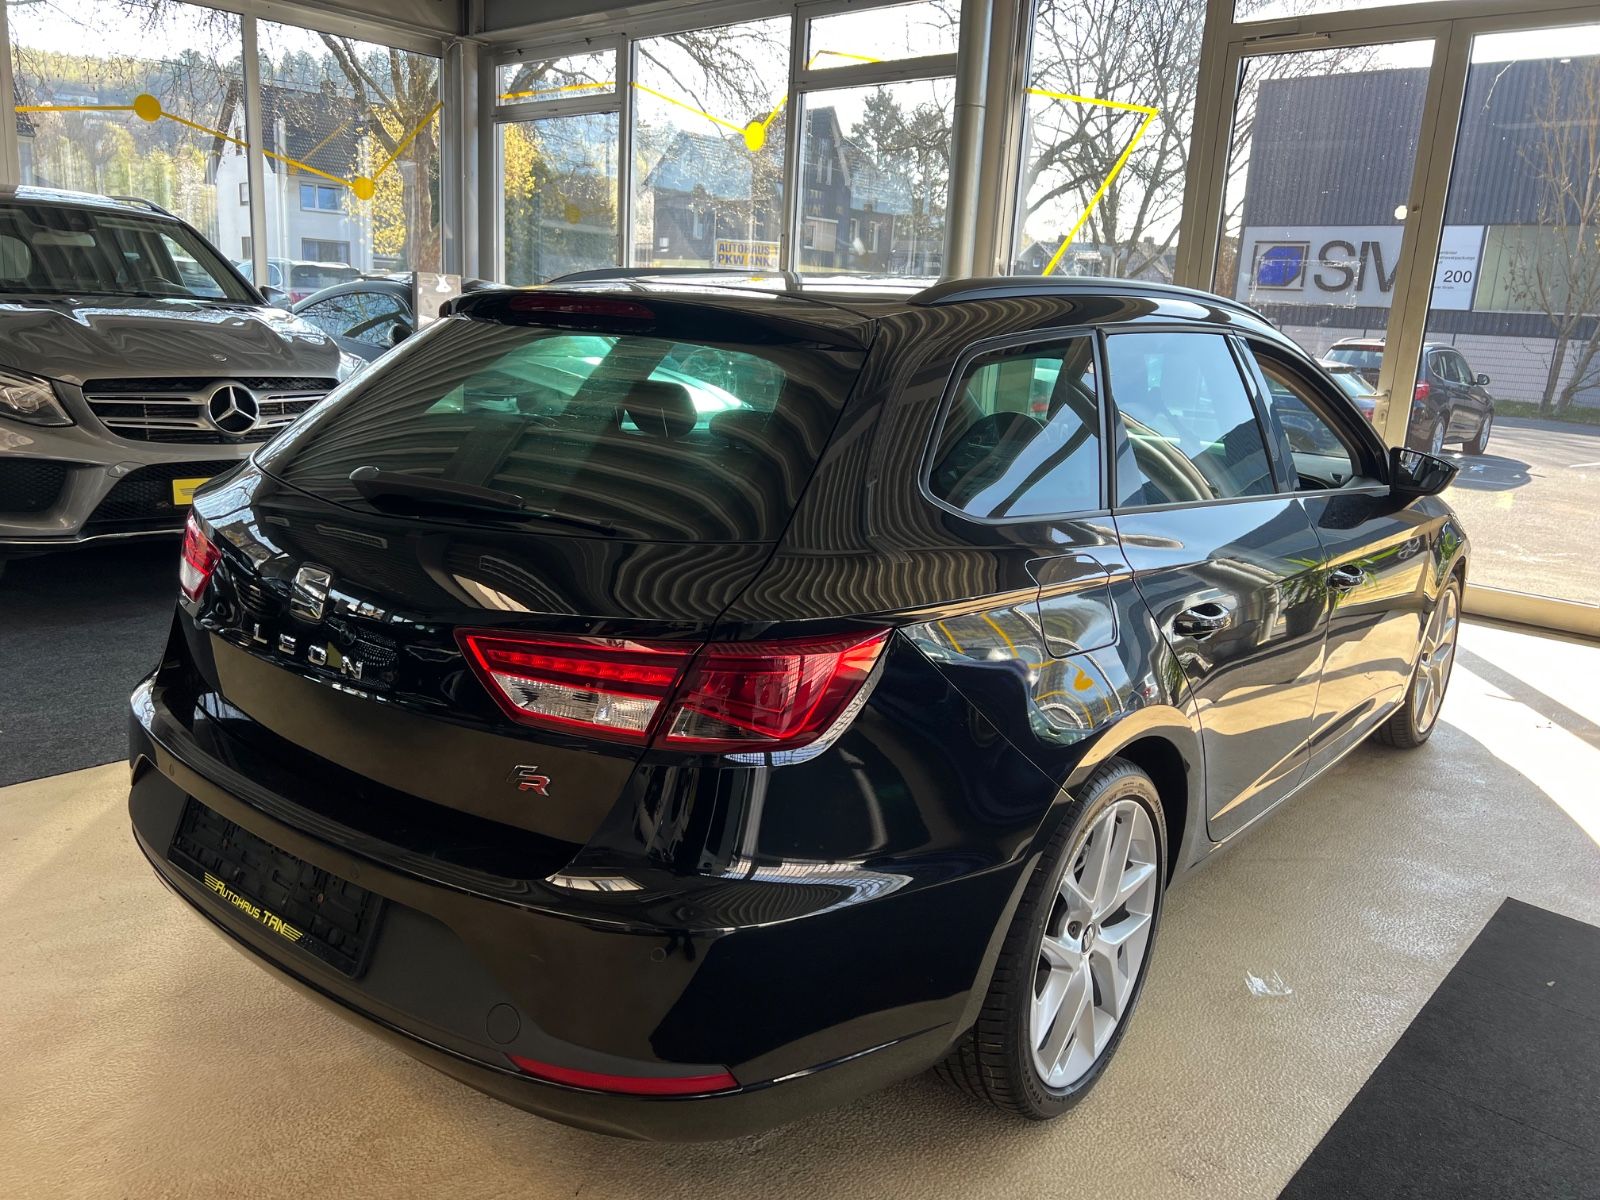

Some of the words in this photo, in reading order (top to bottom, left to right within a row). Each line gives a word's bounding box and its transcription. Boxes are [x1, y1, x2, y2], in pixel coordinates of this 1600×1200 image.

[718, 253, 745, 265] PKW
[1443, 270, 1472, 283] 200
[252, 623, 364, 680] LEON
[506, 765, 550, 796] FR
[215, 880, 261, 919] AUTOHAUS
[262, 910, 287, 934] TAN
